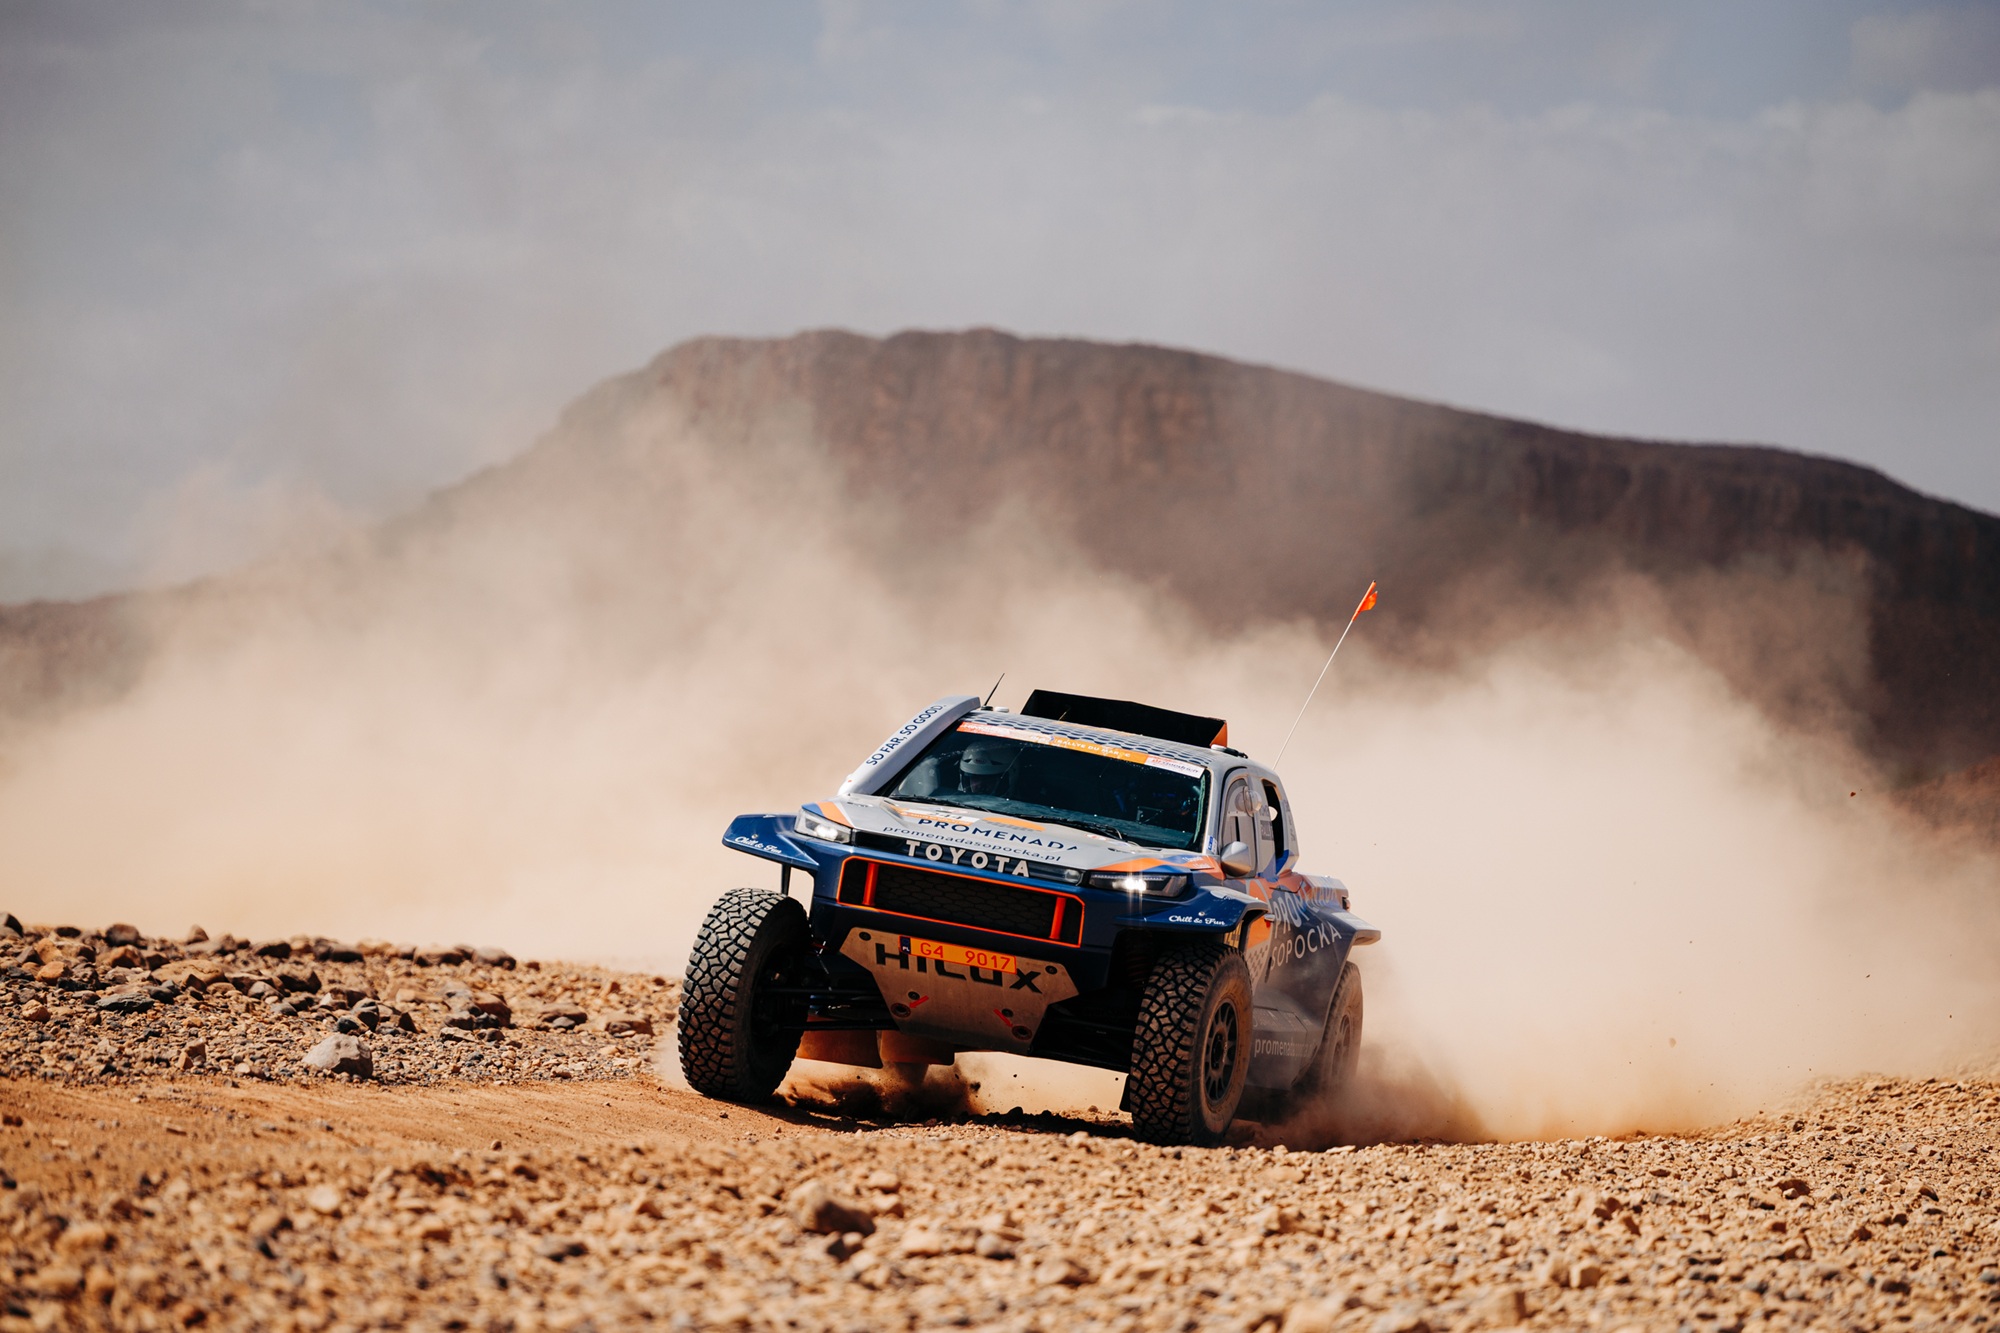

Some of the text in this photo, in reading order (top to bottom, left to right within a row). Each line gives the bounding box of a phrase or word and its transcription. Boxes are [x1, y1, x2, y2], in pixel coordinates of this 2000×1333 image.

[866, 753, 885, 766] SO
[880, 737, 907, 753] FAR,
[899, 724, 918, 736] SO
[1057, 739, 1085, 749] RALLYE
[735, 836, 758, 846] Chill
[764, 844, 782, 854] Fun
[883, 826, 1061, 862] promenadasopocka.pl
[905, 840, 1029, 878] TOYOTA
[1169, 915, 1192, 923] Chill
[1204, 918, 1226, 926] Fun
[920, 942, 1011, 970] G4 9017
[1270, 921, 1342, 970] SOPOCKA
[875, 942, 1043, 994] HILUX
